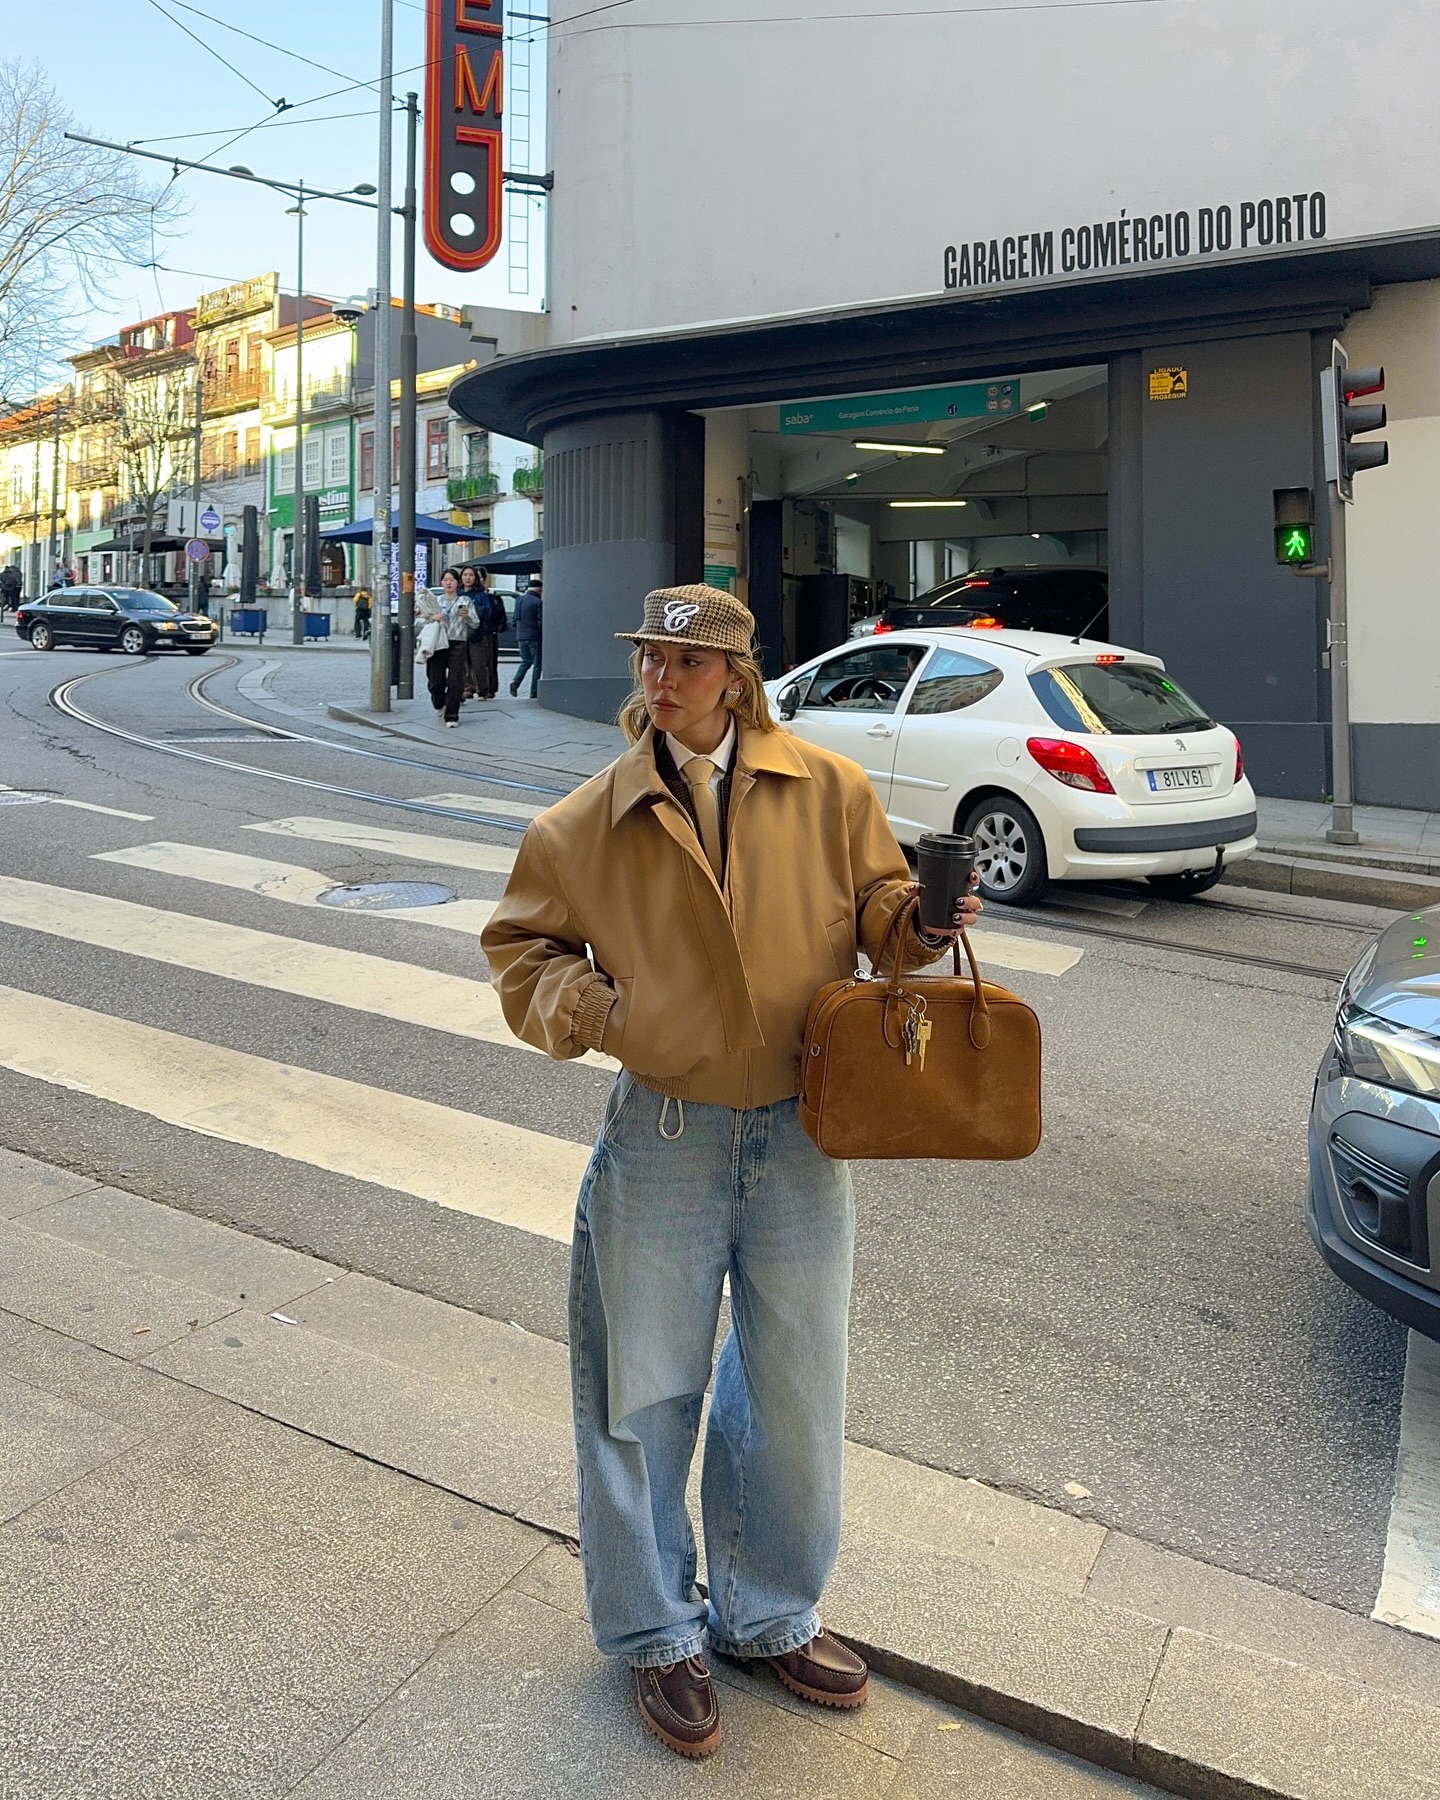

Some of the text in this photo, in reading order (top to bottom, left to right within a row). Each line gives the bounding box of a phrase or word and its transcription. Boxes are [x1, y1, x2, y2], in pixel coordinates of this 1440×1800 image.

[944, 192, 1326, 289] GARAGEM COMÉRCIO DO PORTO
[838, 411, 865, 420] Garagem
[902, 405, 920, 413] Porto
[664, 601, 700, 632] C
